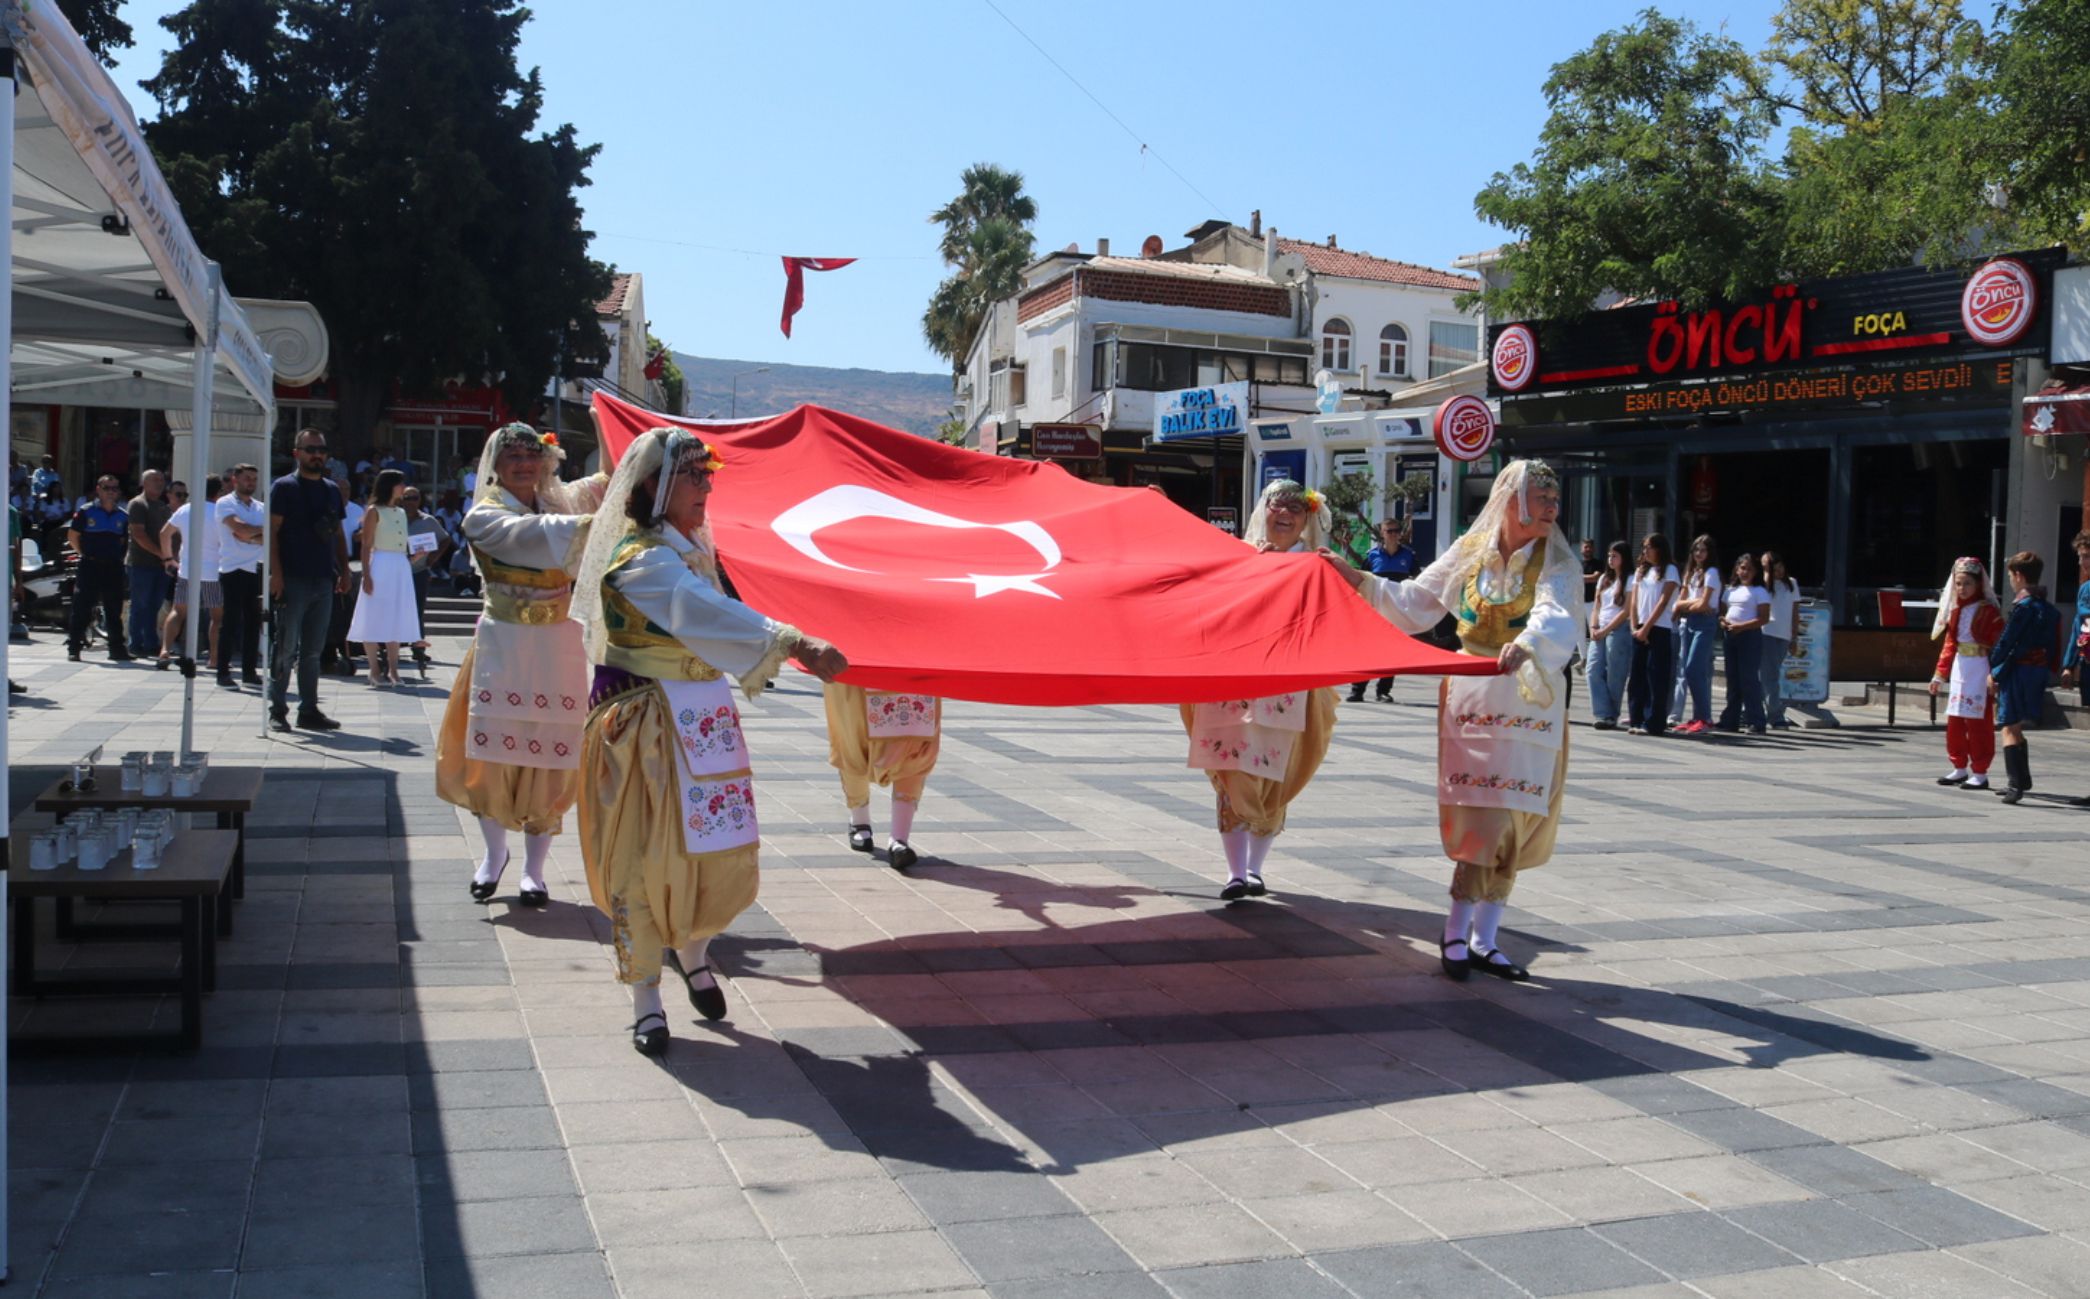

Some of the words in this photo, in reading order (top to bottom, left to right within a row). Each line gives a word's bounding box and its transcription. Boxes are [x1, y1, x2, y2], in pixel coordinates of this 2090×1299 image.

[1853, 311, 1907, 336] FOÇA
[1180, 388, 1216, 409] FOÇA
[1667, 388, 1712, 412] FOÇA
[1717, 382, 1770, 406] ÖNCÜ
[1773, 376, 1848, 401] DÖNERİ
[1852, 373, 1897, 400] ÇOK
[1902, 363, 1973, 392] SEVDİ!
[1160, 409, 1206, 434] BALIK
[1207, 404, 1237, 429] EVİ
